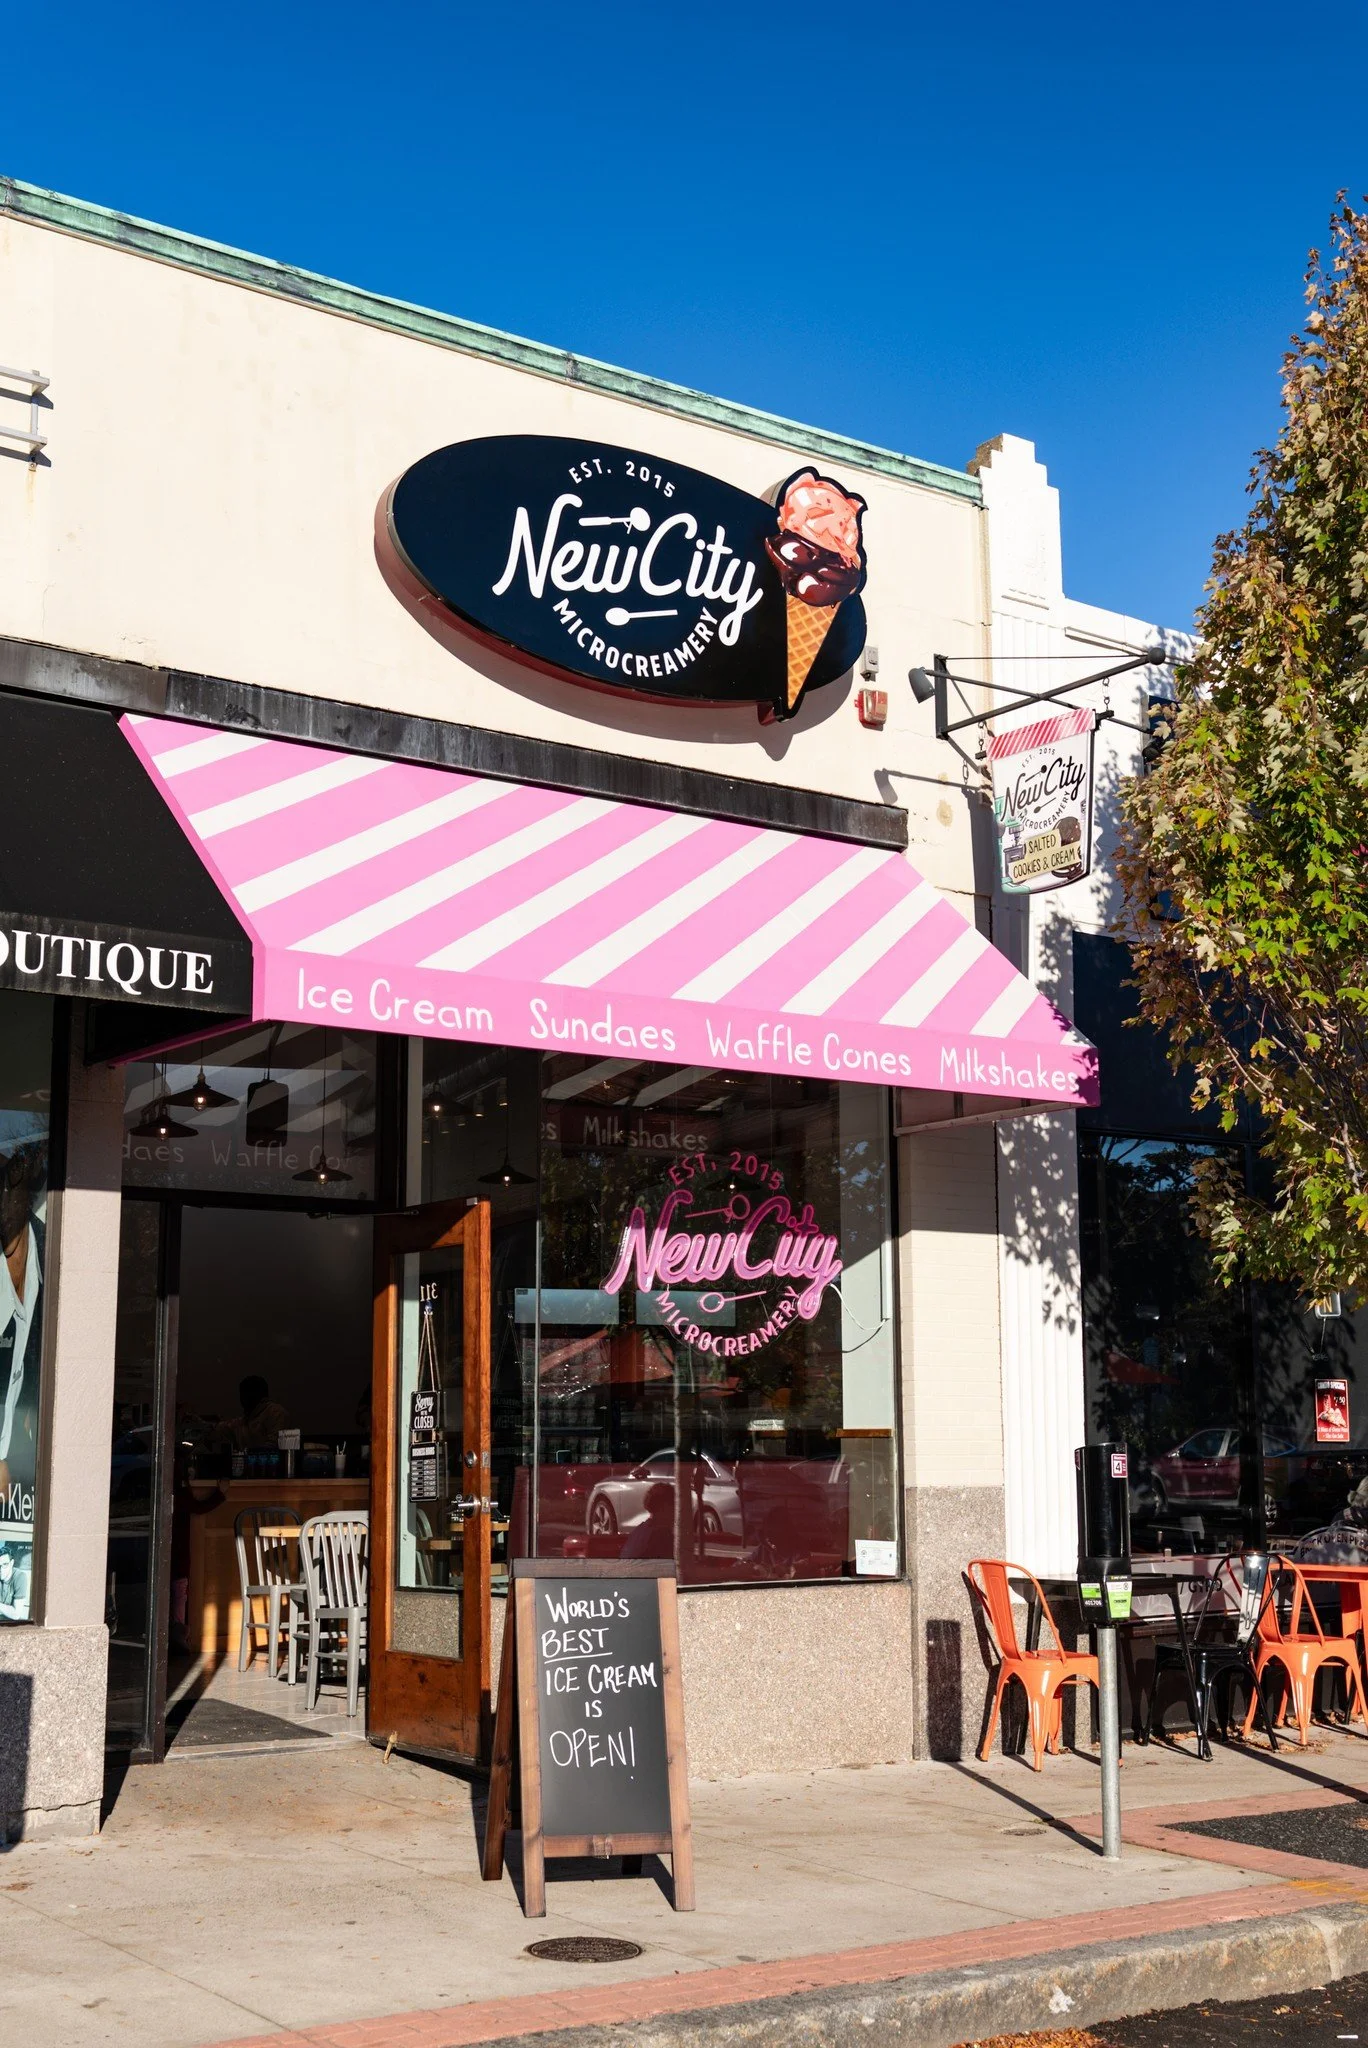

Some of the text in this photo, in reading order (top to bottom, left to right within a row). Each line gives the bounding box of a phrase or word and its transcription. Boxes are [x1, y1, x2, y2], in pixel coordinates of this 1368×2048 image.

[569, 458, 676, 498] EST. 2015
[552, 598, 718, 678] MICROCREAMERY
[1039, 747, 1056, 756] 2015
[1018, 790, 1071, 830] MICROCREAMERY
[1013, 847, 1076, 879] COOKIES & CREAM
[1028, 834, 1057, 854] SALTED
[0, 929, 213, 995] UTIQUE
[297, 967, 494, 1032] Ice Cream
[528, 998, 677, 1052] Sundaes
[705, 1018, 913, 1077] Waffle Cones
[939, 1046, 1080, 1093] Milkshakes
[582, 1114, 709, 1152] Milkshakes
[210, 1139, 300, 1171] Waffle
[668, 1151, 785, 1190] EST. 2015
[656, 1286, 802, 1358] MICROCREAMERY
[414, 1415, 434, 1429] CLOSED
[415, 1393, 434, 1413] Sorry
[545, 1587, 631, 1625] WORLD'S
[541, 1627, 610, 1659] BEST
[546, 1661, 658, 1696] ICE CREAM
[585, 1700, 603, 1718] IS
[550, 1726, 636, 1780] OPEN!
